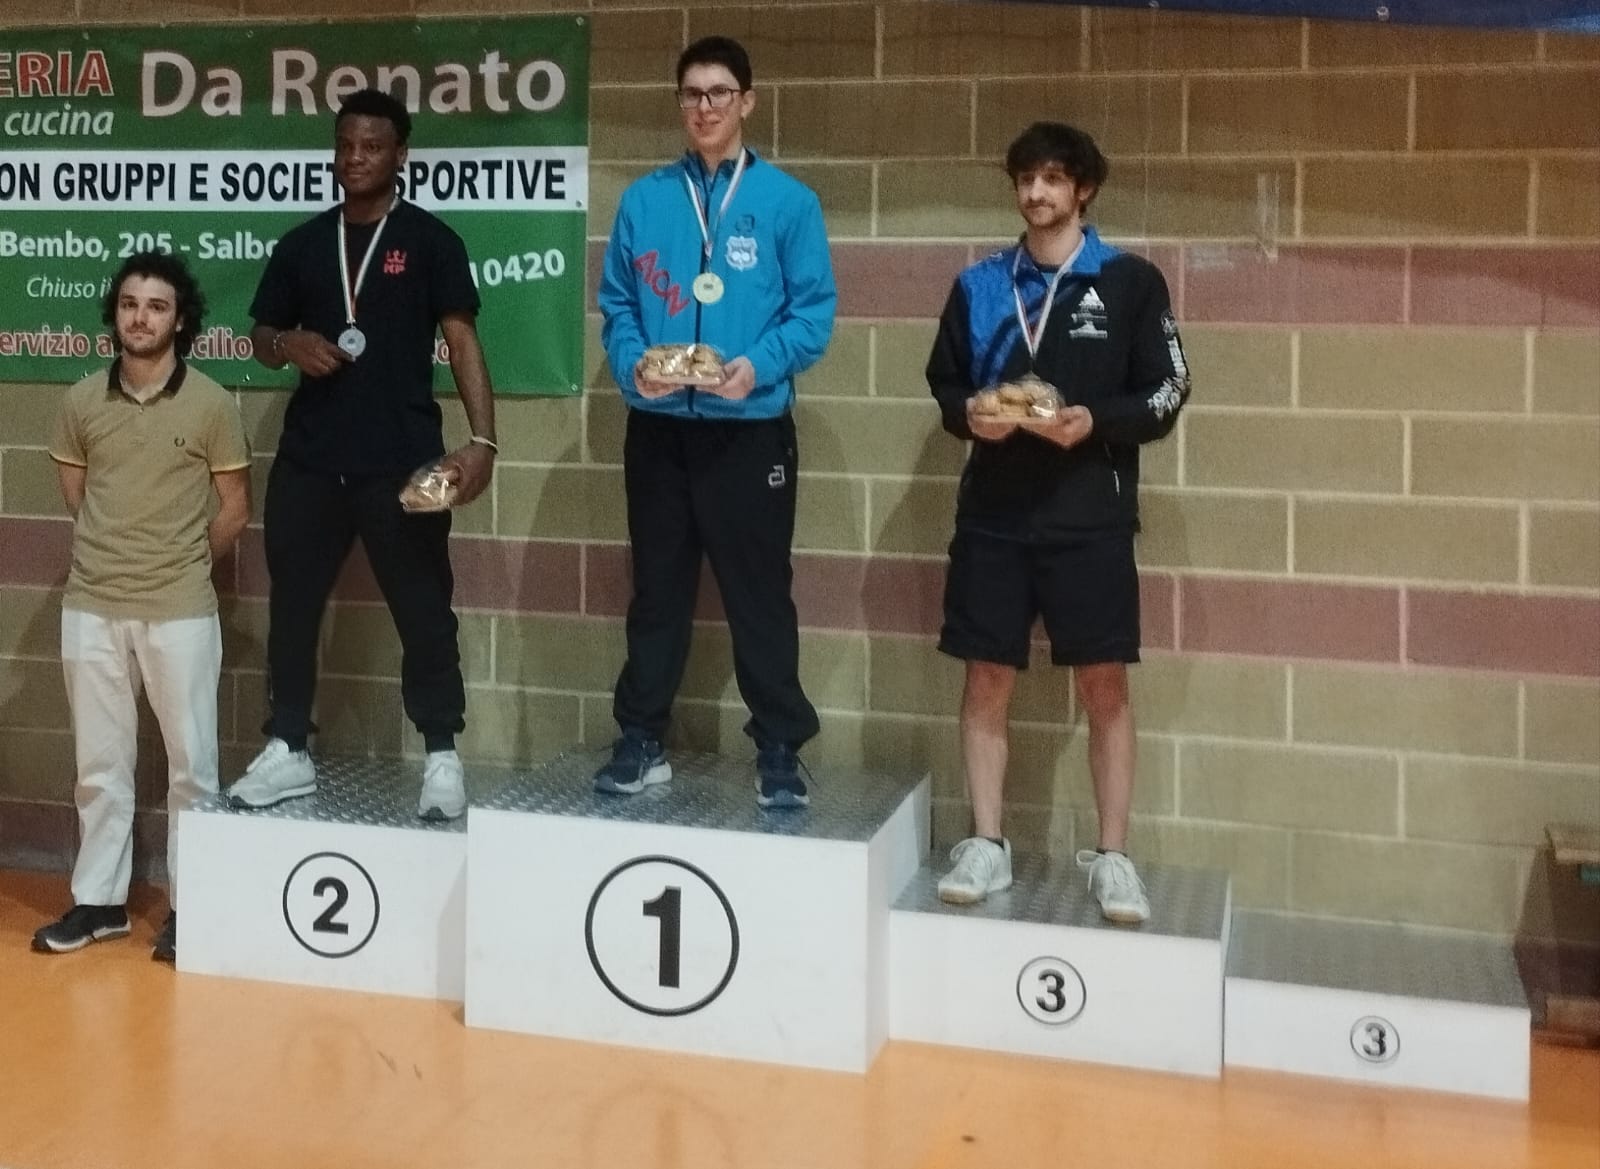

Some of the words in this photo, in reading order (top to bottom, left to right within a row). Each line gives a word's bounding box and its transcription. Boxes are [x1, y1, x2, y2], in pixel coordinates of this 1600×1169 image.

[142, 50, 243, 117] Da
[271, 49, 566, 116] Renato
[4, 102, 115, 136] cucina
[53, 162, 176, 201] GRUPPI
[189, 163, 209, 201] E
[220, 161, 341, 202] SOCIET
[0, 229, 110, 262] Bembo,
[117, 232, 173, 258] 205
[26, 276, 96, 298] Chiuso
[96, 333, 115, 358] a
[313, 876, 350, 935] 2
[642, 885, 682, 989] 1
[1035, 968, 1066, 1013] 3
[1363, 1022, 1387, 1057] 3
